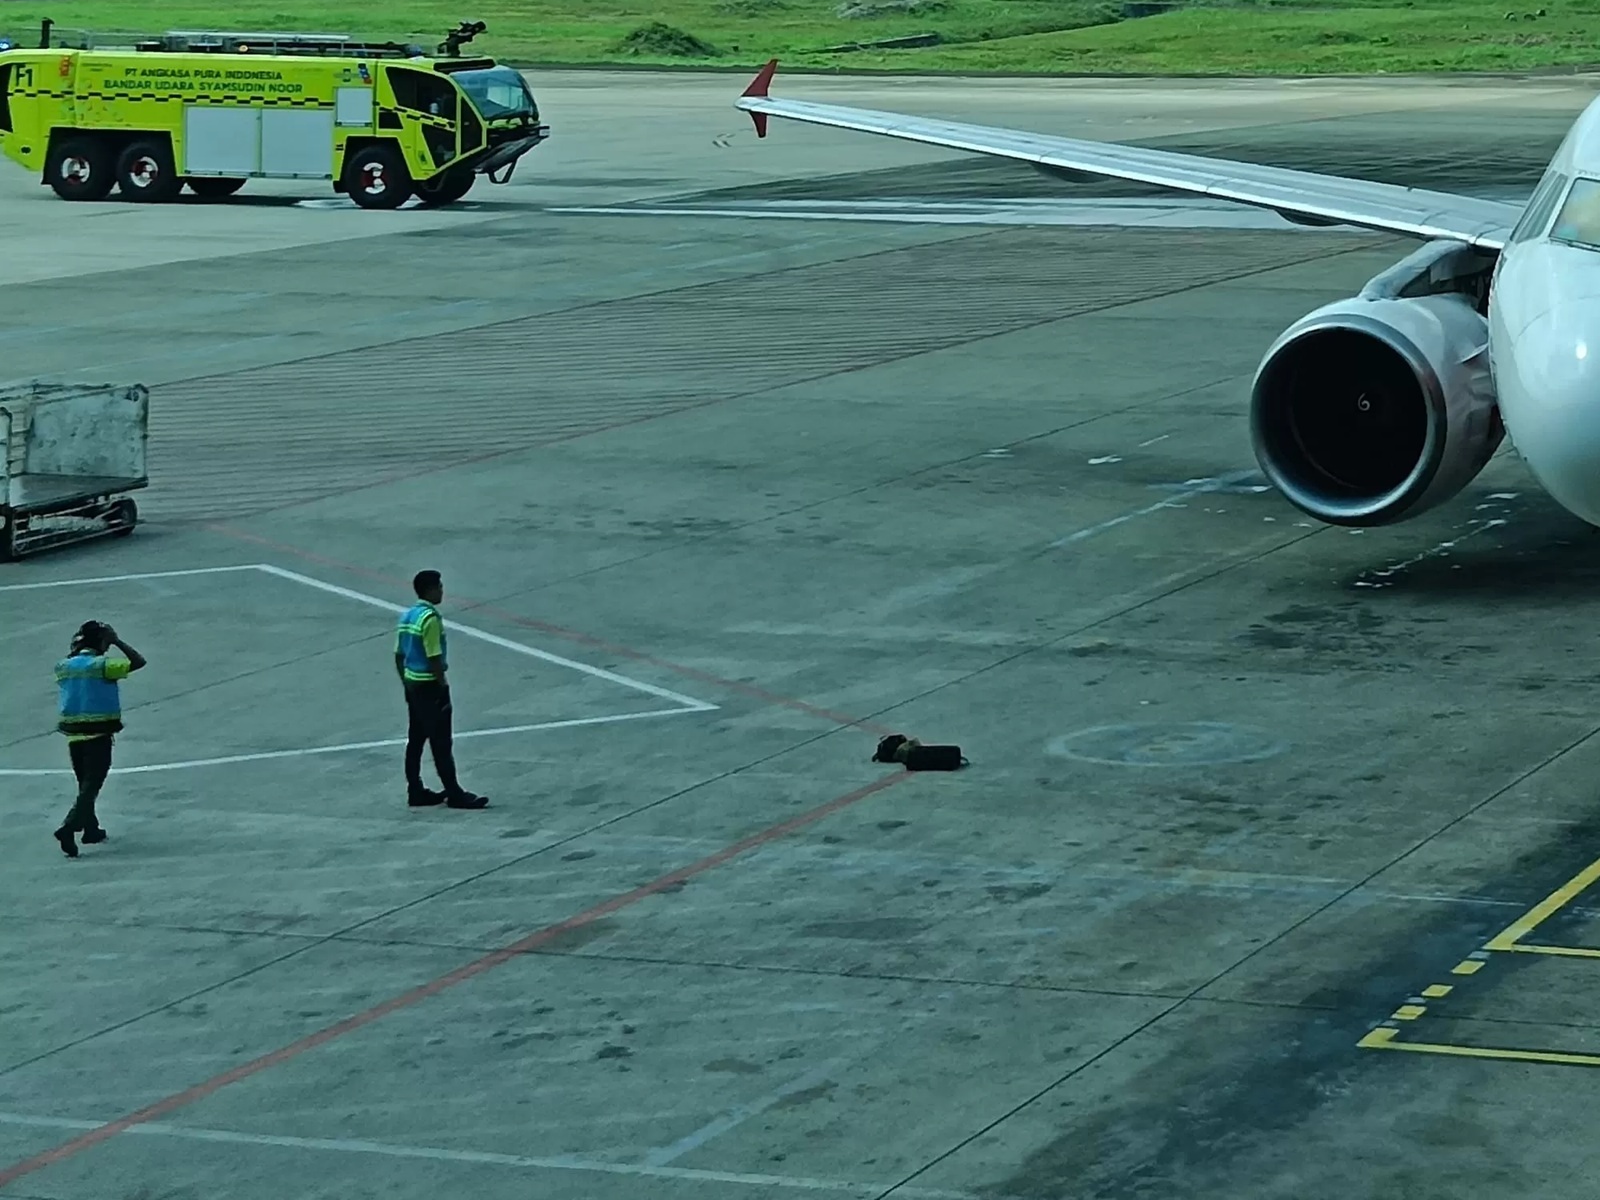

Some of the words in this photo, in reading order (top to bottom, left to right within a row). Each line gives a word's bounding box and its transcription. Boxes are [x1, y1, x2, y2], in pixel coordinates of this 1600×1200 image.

[125, 68, 137, 76] PT
[141, 68, 190, 78] ANGKASA
[194, 69, 221, 78] PURA
[225, 70, 283, 80] INDONESIA
[104, 80, 151, 89] BANDAR
[155, 81, 195, 90] UDARA
[199, 82, 265, 92] SYAMSUDIN
[269, 83, 302, 93] NOOR
